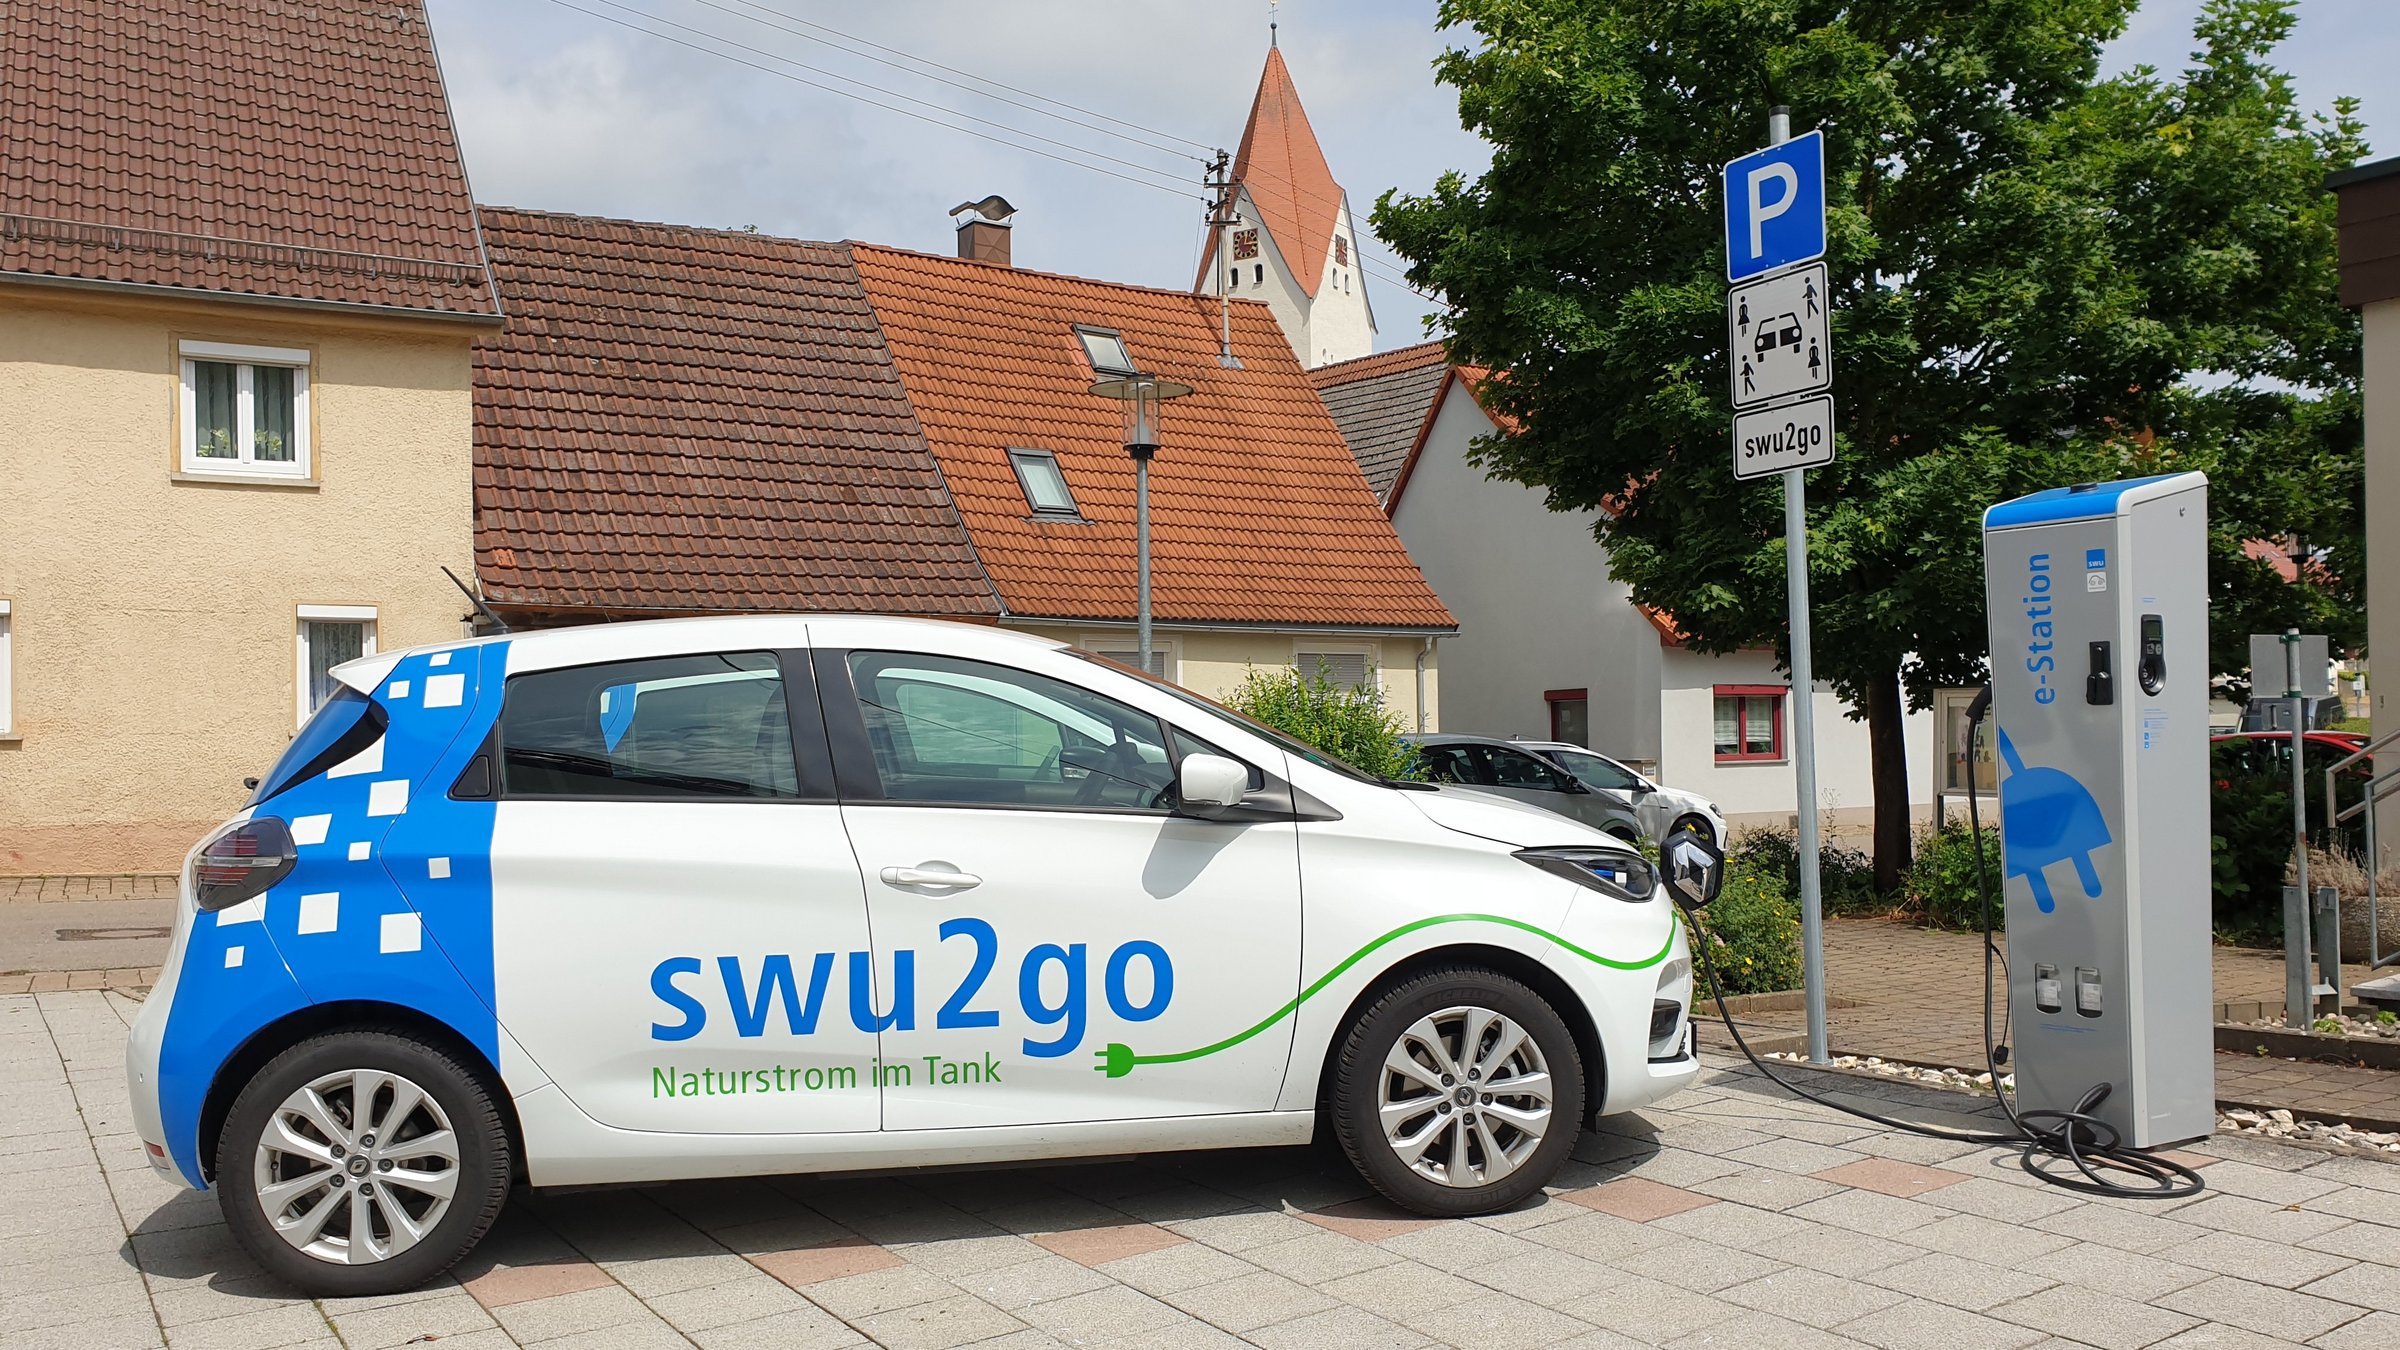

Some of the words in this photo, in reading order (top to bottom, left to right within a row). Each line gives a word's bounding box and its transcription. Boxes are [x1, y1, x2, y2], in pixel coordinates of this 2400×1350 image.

[1748, 161, 1799, 260] P
[1744, 421, 1823, 459] swu2go
[2022, 553, 2056, 705] e-Station
[651, 917, 1174, 1058] swu2go
[653, 1065, 857, 1098] Naturstrom
[872, 1057, 912, 1087] im
[923, 1051, 1002, 1085] Tank
